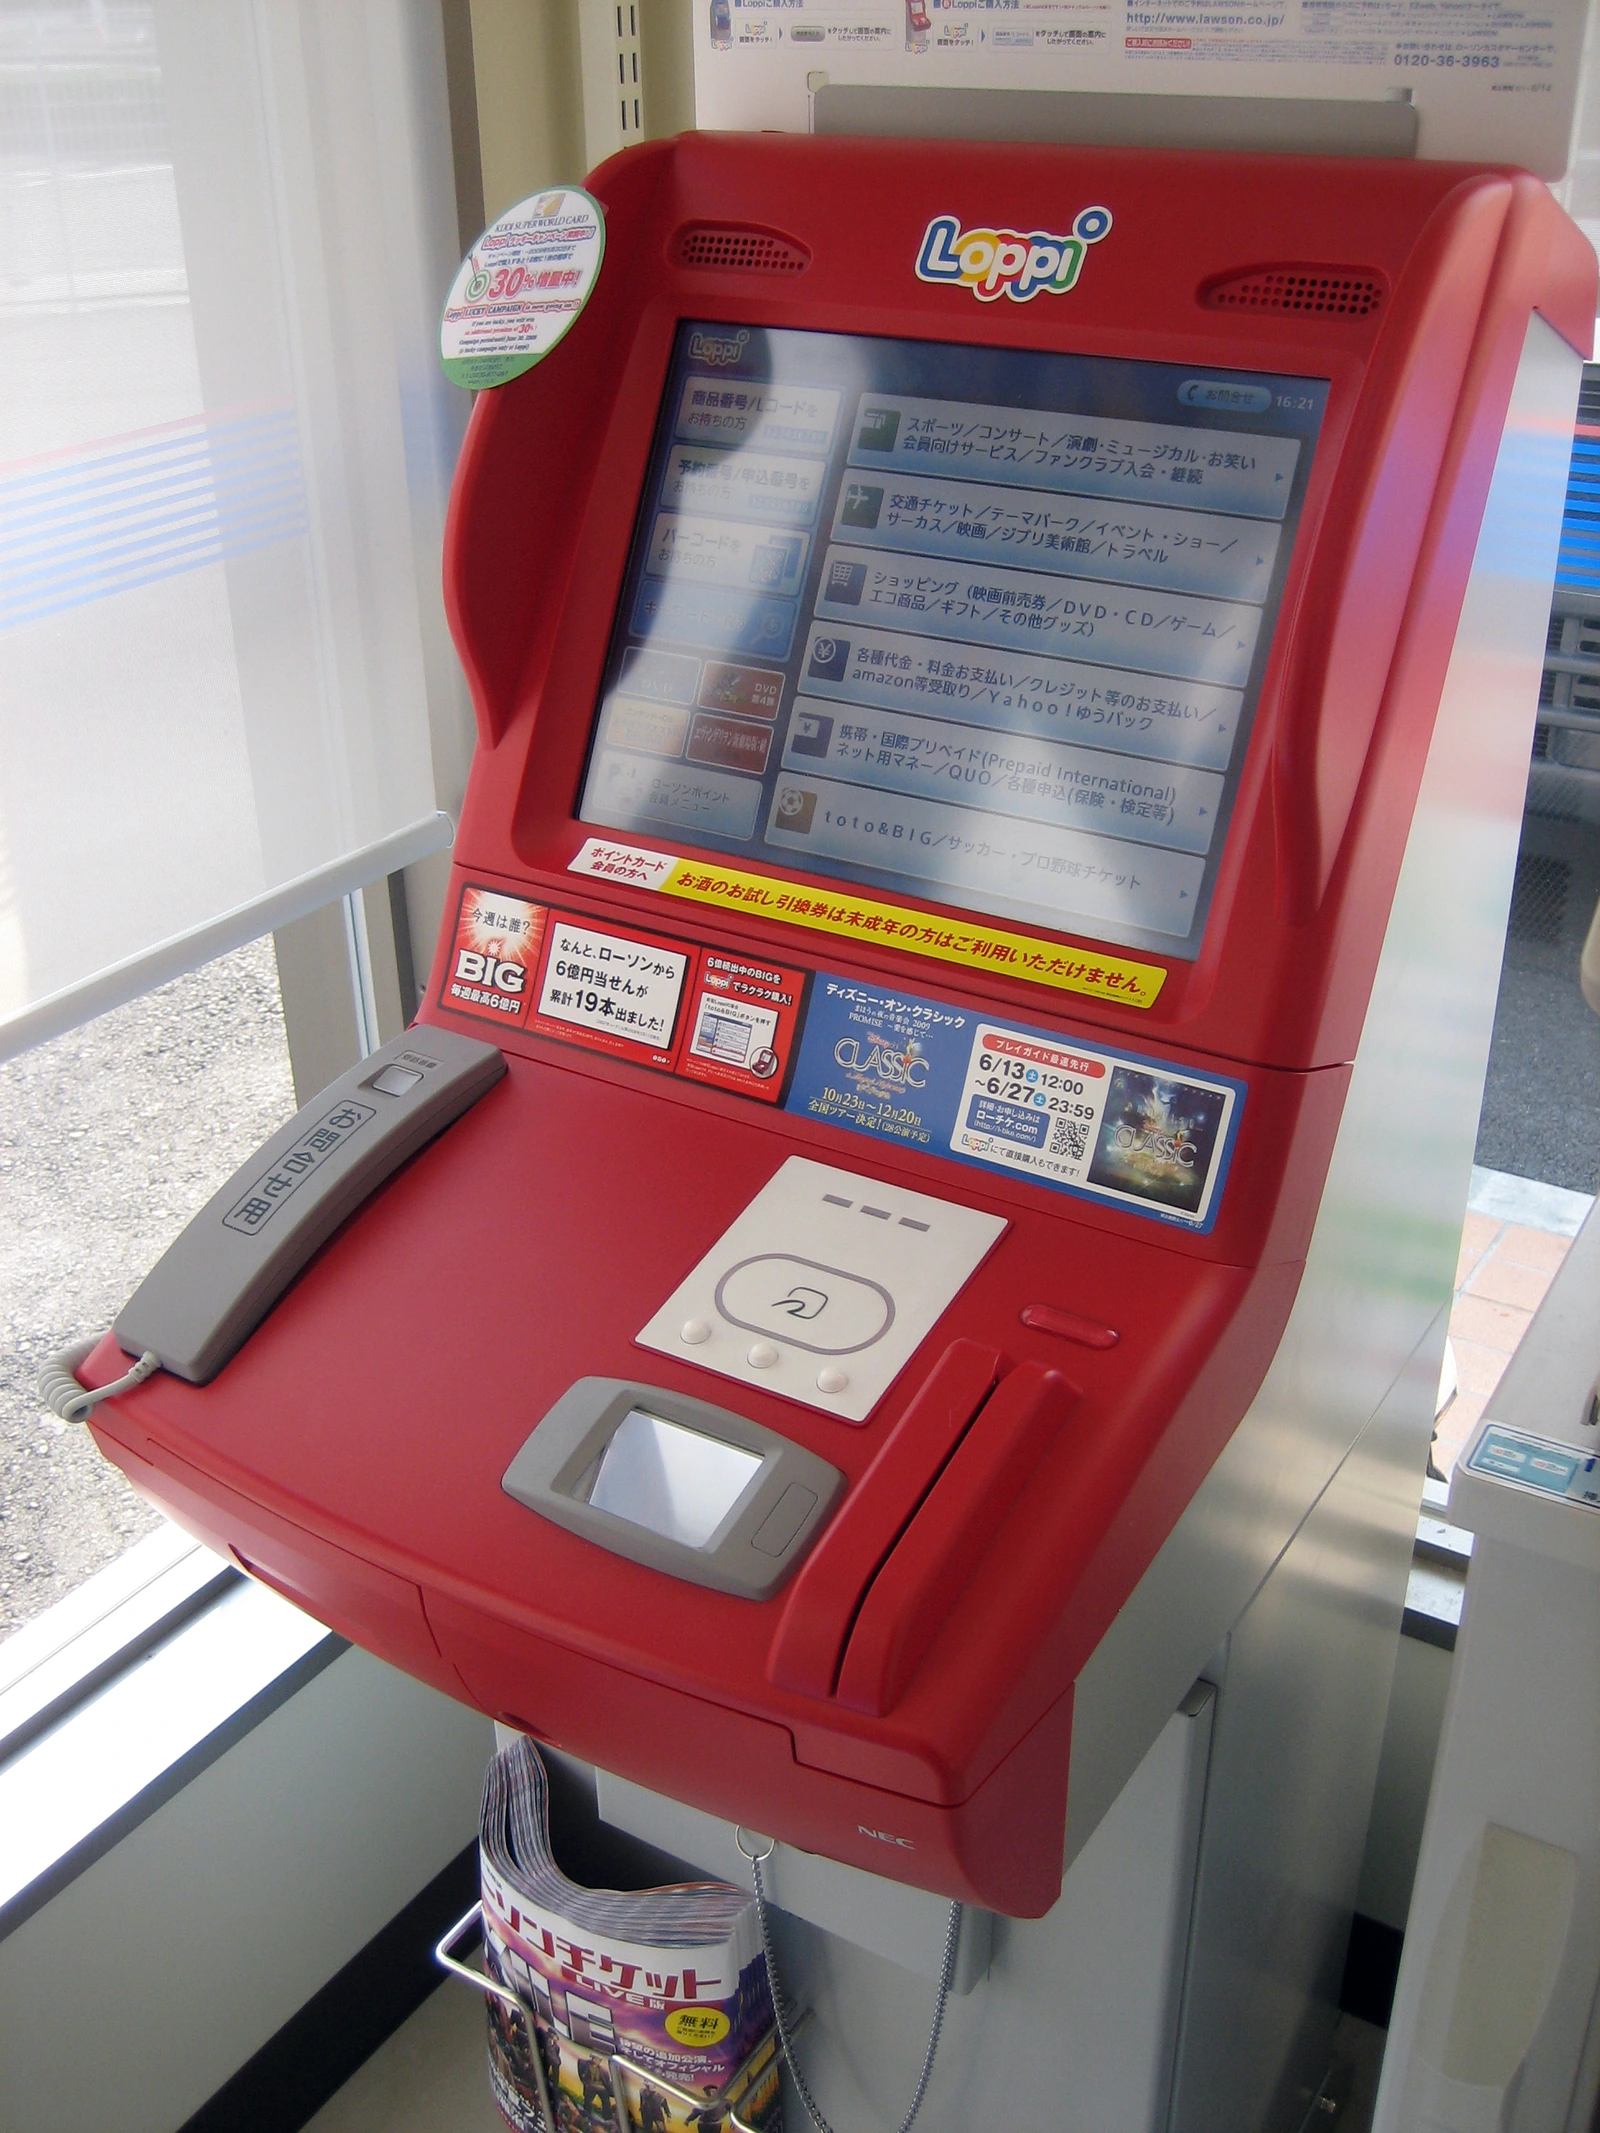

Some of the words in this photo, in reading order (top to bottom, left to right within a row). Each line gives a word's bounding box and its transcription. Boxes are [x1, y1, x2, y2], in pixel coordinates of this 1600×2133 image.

[1126, 13, 1286, 28] http://www.lawson.co.jp/
[1394, 54, 1500, 68] 0120-36-3963
[565, 214, 589, 226] CARD
[915, 205, 1113, 303] Loppi
[688, 329, 750, 367] Loppi
[690, 389, 819, 419] 商品番号/Lコードを
[1205, 388, 1255, 405] お問合せ
[1276, 395, 1315, 411] 16:21
[687, 411, 748, 432] お持ちの方
[885, 511, 1170, 565] サーカス／映画／ジブリ美術館／トラベル
[753, 681, 778, 696] DVD
[1056, 766, 1178, 805] International)
[589, 861, 649, 881] 会員の方へ
[590, 846, 669, 872] ポイントカード
[471, 908, 532, 936] 今週は誰?
[676, 870, 1147, 998] お酒のお試し引換券は未成年の方はご利用いただけません。
[454, 948, 526, 994] BIG
[560, 937, 675, 980] なんと、ローソンから
[706, 956, 782, 985] 6億続出中のBIGを
[555, 960, 649, 998] 6億円当せんが
[704, 971, 734, 990] Loppi
[450, 983, 521, 1014] 毎週最高6億円
[549, 988, 665, 1032] 累計19本出ました!
[826, 983, 967, 1030] ディズニー・オン・クラシック
[848, 1012, 884, 1028] PROMISE
[912, 1018, 931, 1031] 2009
[834, 1037, 930, 1089] CLASSIC
[995, 1039, 1090, 1073] プレイガイド最速先行
[979, 1053, 1026, 1080] 6/13
[1041, 1073, 1084, 1096] 12:00
[976, 1110, 1039, 1135] ローチケ.com
[978, 1100, 1041, 1124] 詳細・お申し込みは
[1048, 1097, 1095, 1121] 23:59
[962, 1133, 994, 1152] Loppi
[1114, 1124, 1198, 1168] CLASSIC
[234, 1108, 363, 1226] お問合せ用
[857, 1825, 916, 1850] NEC
[679, 2013, 720, 2031] 無料
